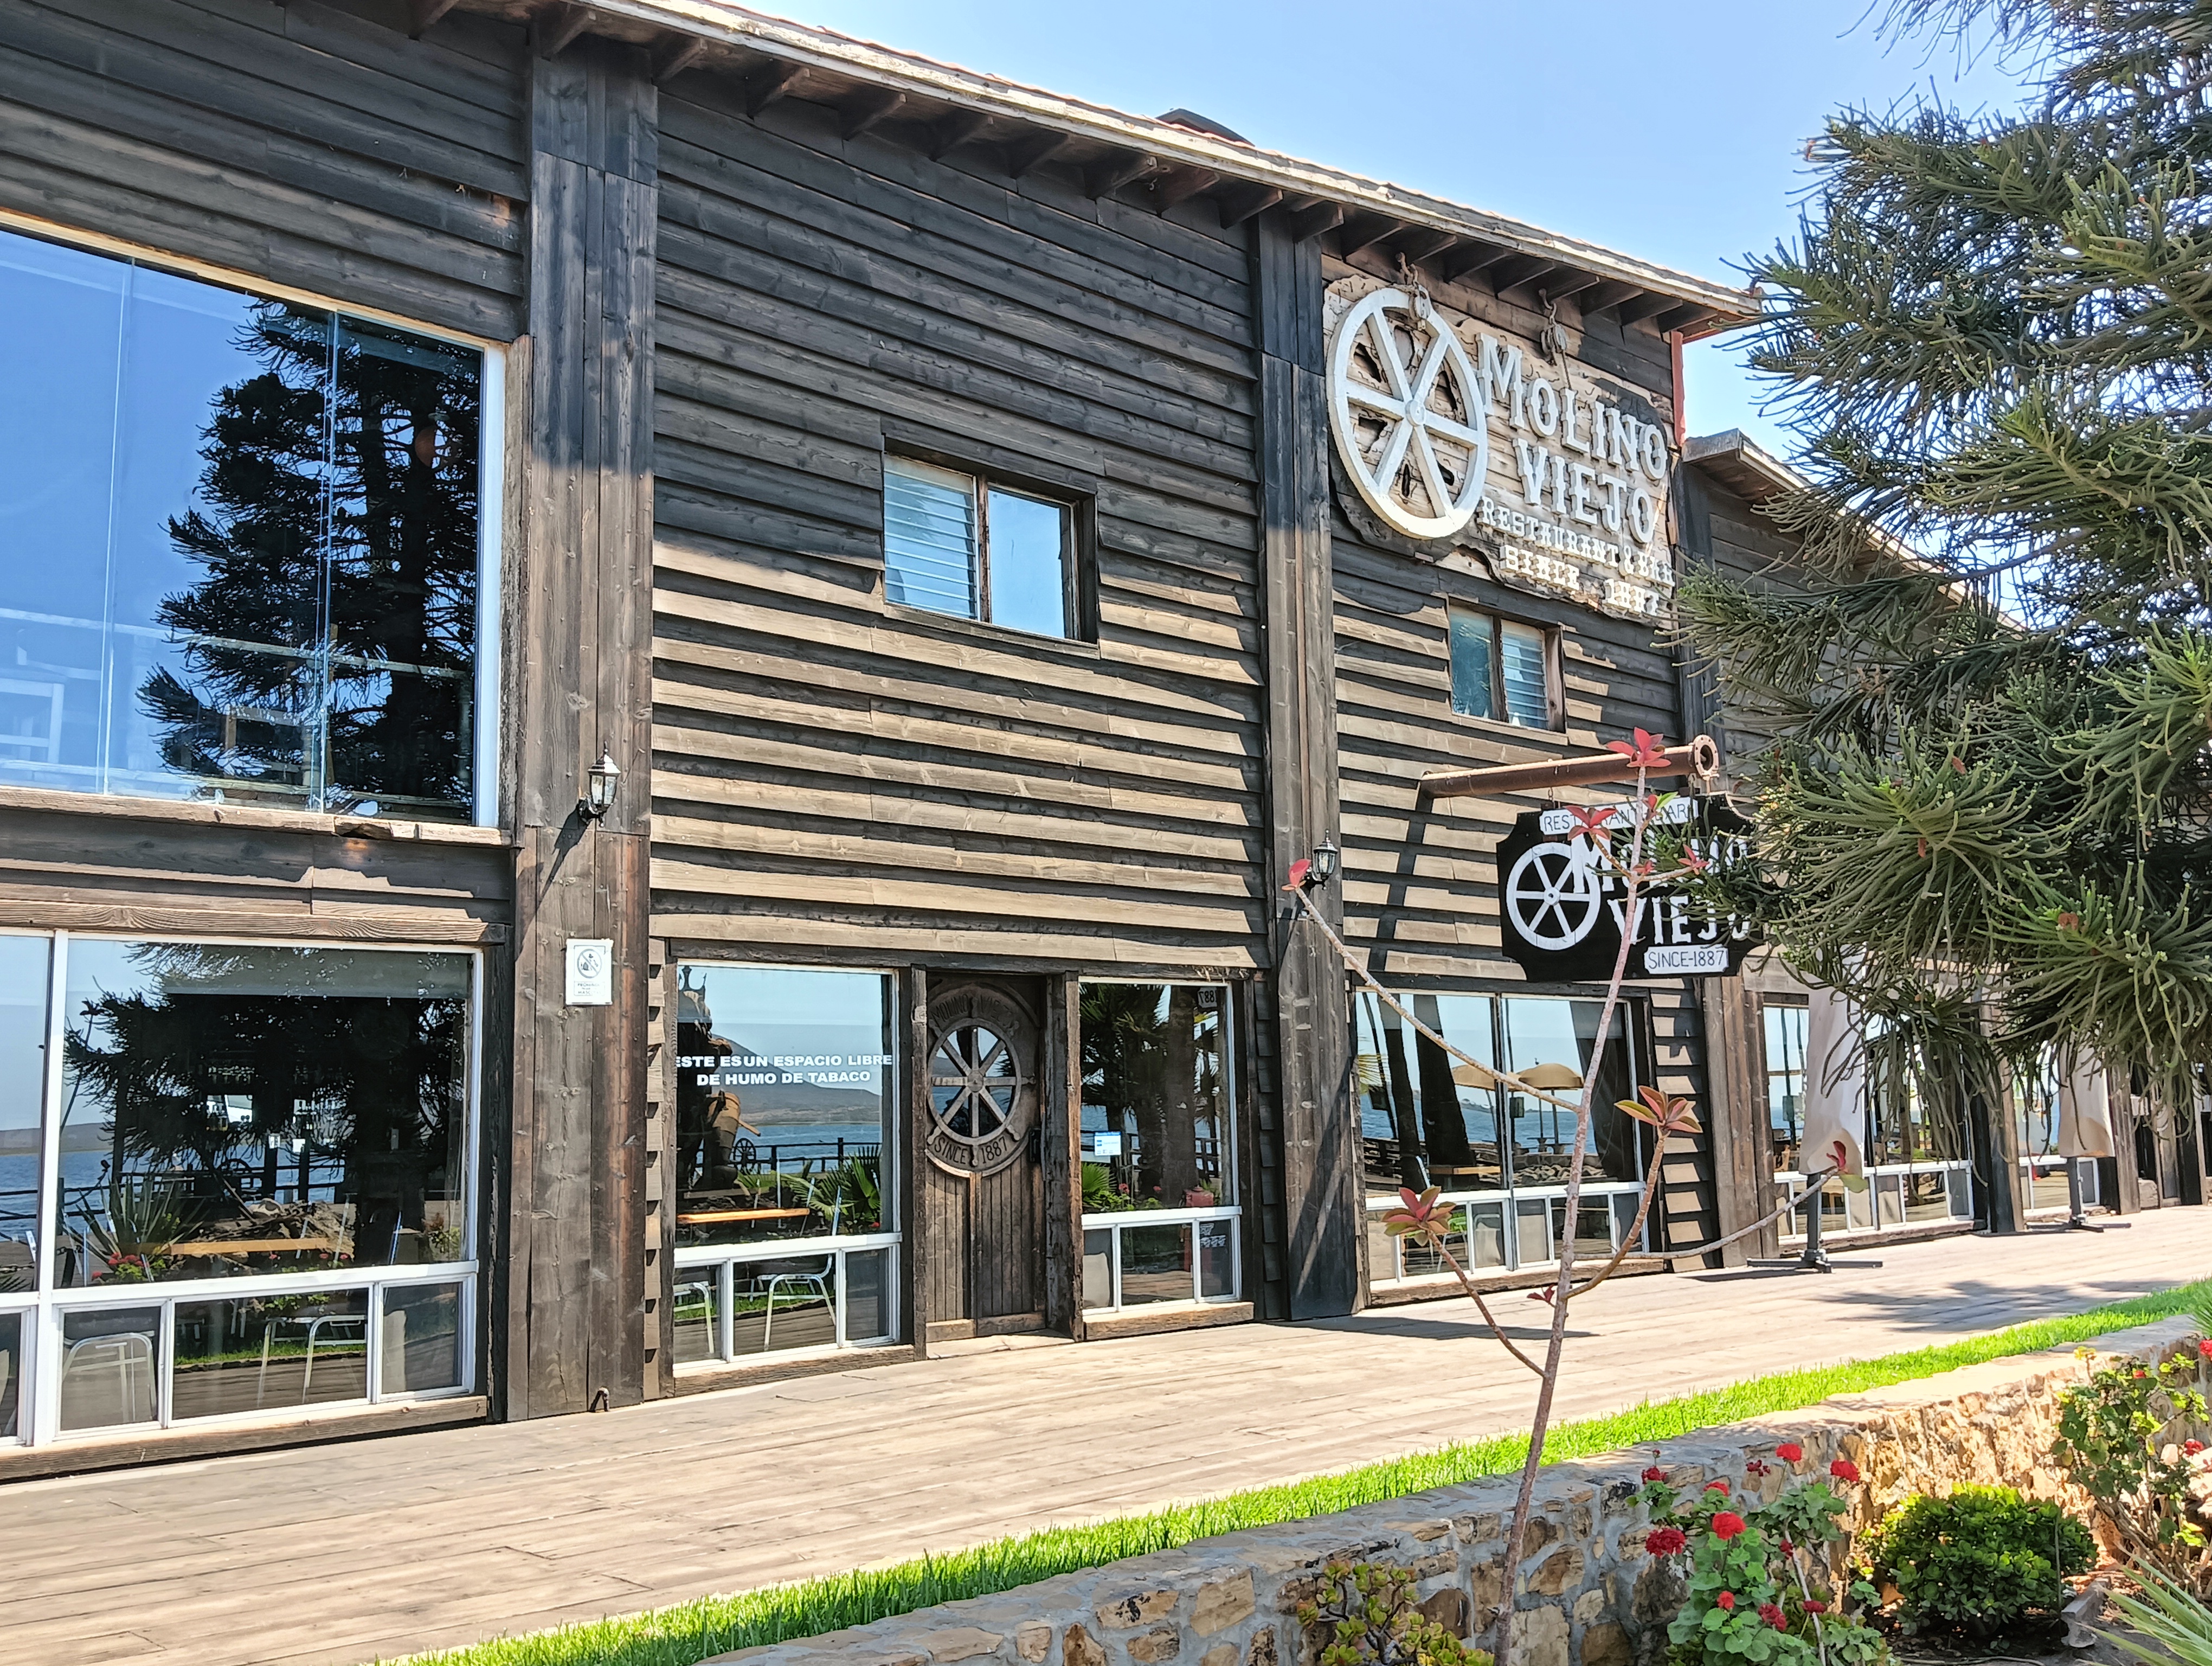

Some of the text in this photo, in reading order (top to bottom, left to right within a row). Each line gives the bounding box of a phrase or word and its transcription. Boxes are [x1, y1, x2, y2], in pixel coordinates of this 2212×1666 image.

[1477, 332, 1668, 480] MOLINO
[1513, 438, 1653, 543] VIEJO
[1478, 496, 1675, 587] RESTAURANT & BAR
[1501, 544, 1659, 616] SINCE 1887
[1649, 951, 1724, 969] SINCE-1887
[931, 994, 969, 1029] MOLINO
[773, 1055, 842, 1067] ESPACIO
[848, 1054, 892, 1066] LIBRE
[697, 1071, 871, 1086] DE HUMO DE TABACO
[934, 1136, 1007, 1165] SINCE 1887
